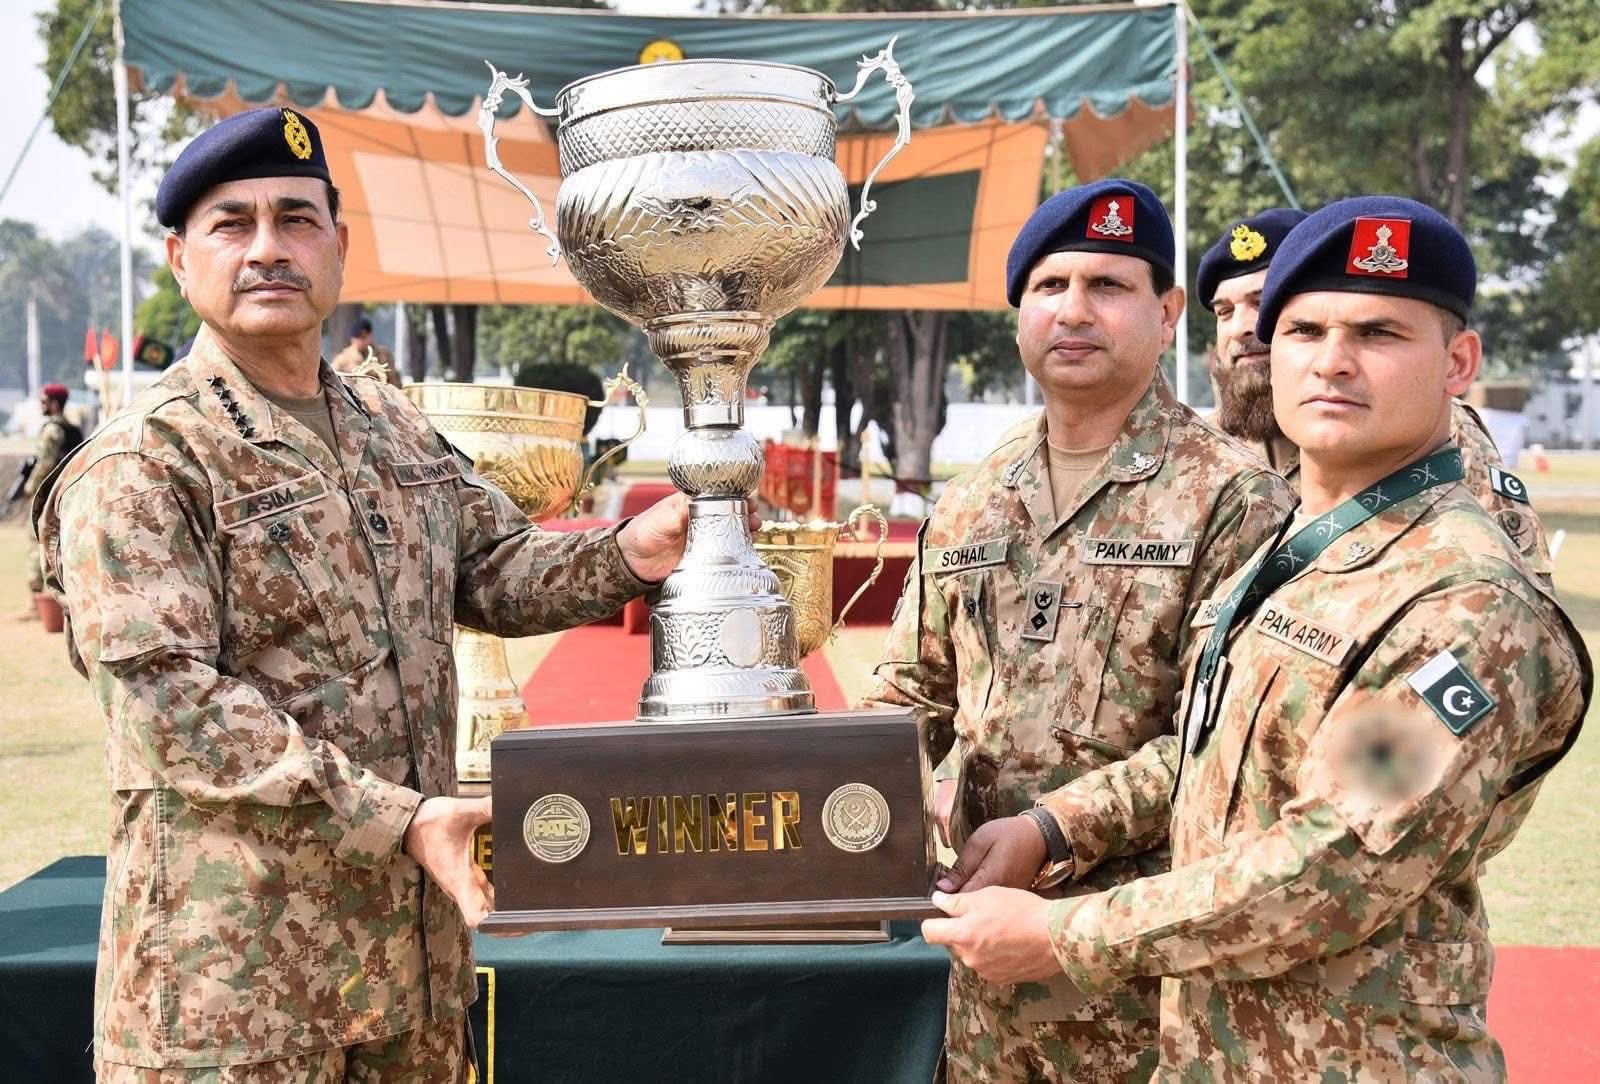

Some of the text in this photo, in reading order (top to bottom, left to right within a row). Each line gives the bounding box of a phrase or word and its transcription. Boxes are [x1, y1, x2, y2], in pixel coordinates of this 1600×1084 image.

[421, 461, 450, 480] ARMY
[247, 487, 295, 517] ASIM
[941, 546, 988, 567] SOHAIL
[1095, 542, 1182, 562] PAK ARMY
[1260, 609, 1343, 655] PAK ARMY
[610, 791, 802, 855] WINNER
